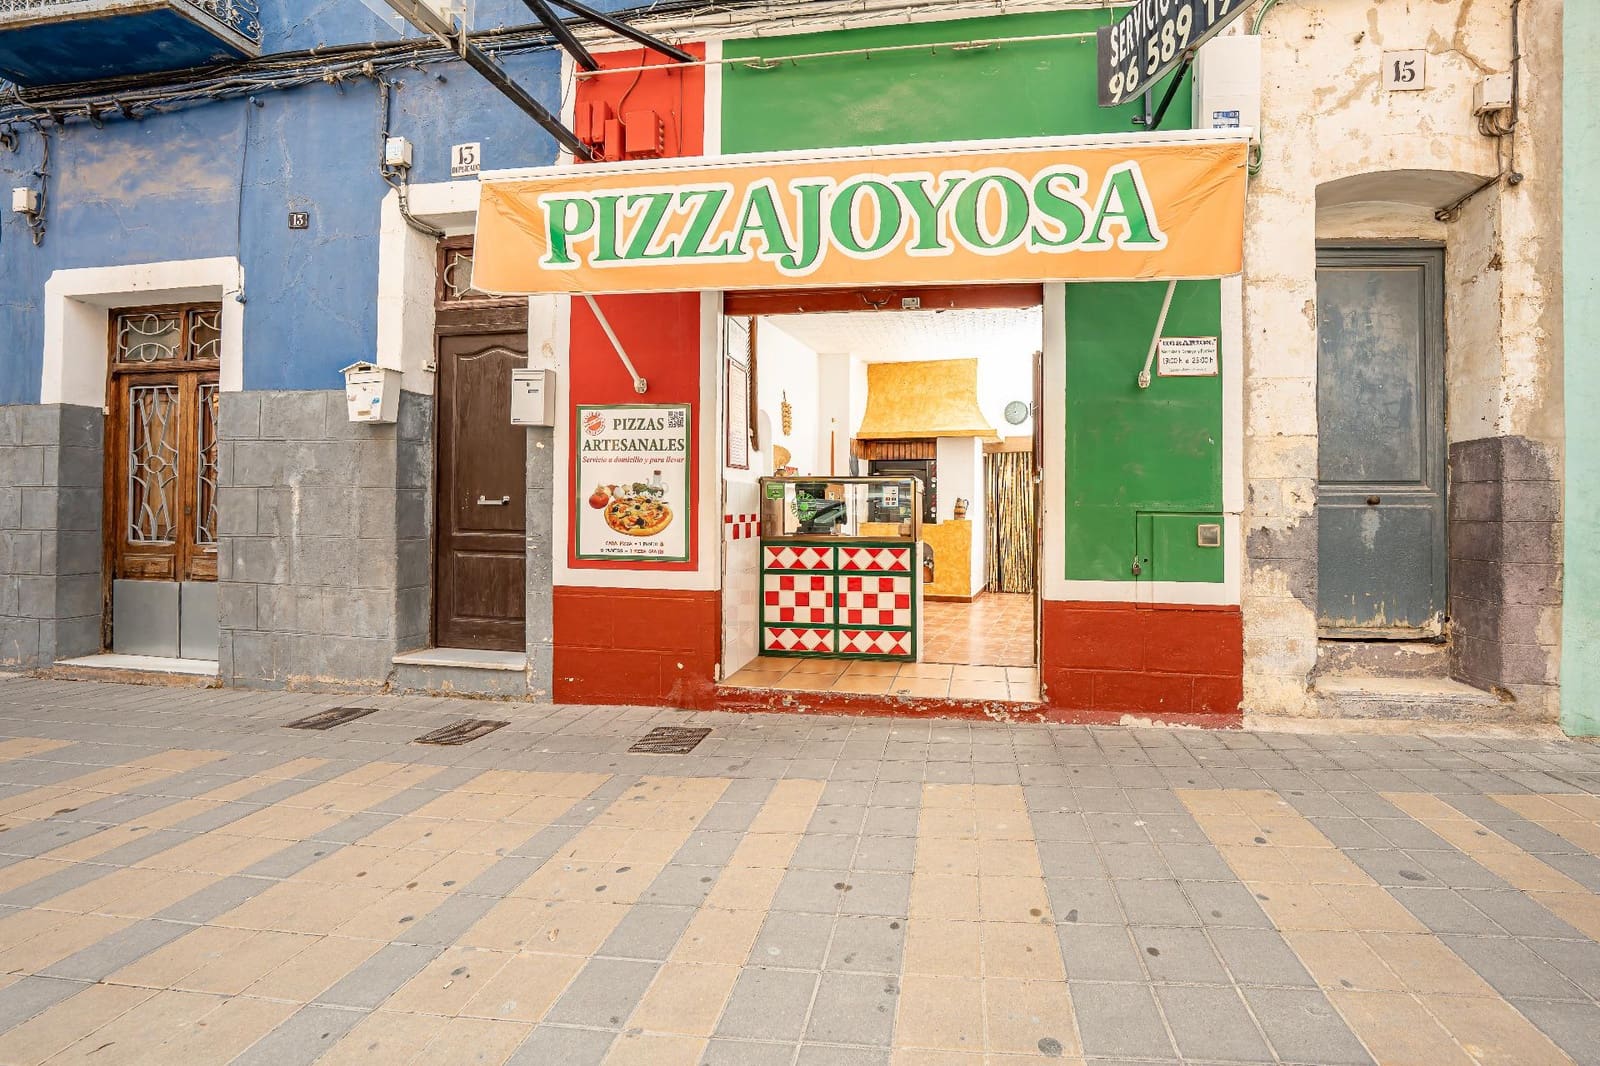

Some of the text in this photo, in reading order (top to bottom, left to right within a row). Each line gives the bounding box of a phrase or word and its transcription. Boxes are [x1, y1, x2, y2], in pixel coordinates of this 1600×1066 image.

[1109, 56, 1139, 103] 96
[1147, 4, 1193, 75] 589
[1394, 60, 1415, 82] 15
[293, 214, 304, 226] 13
[613, 418, 664, 431] PIZZAS
[583, 438, 685, 452] ARTESANALES
[582, 455, 607, 463] Servicio
[614, 455, 643, 463] domicilio
